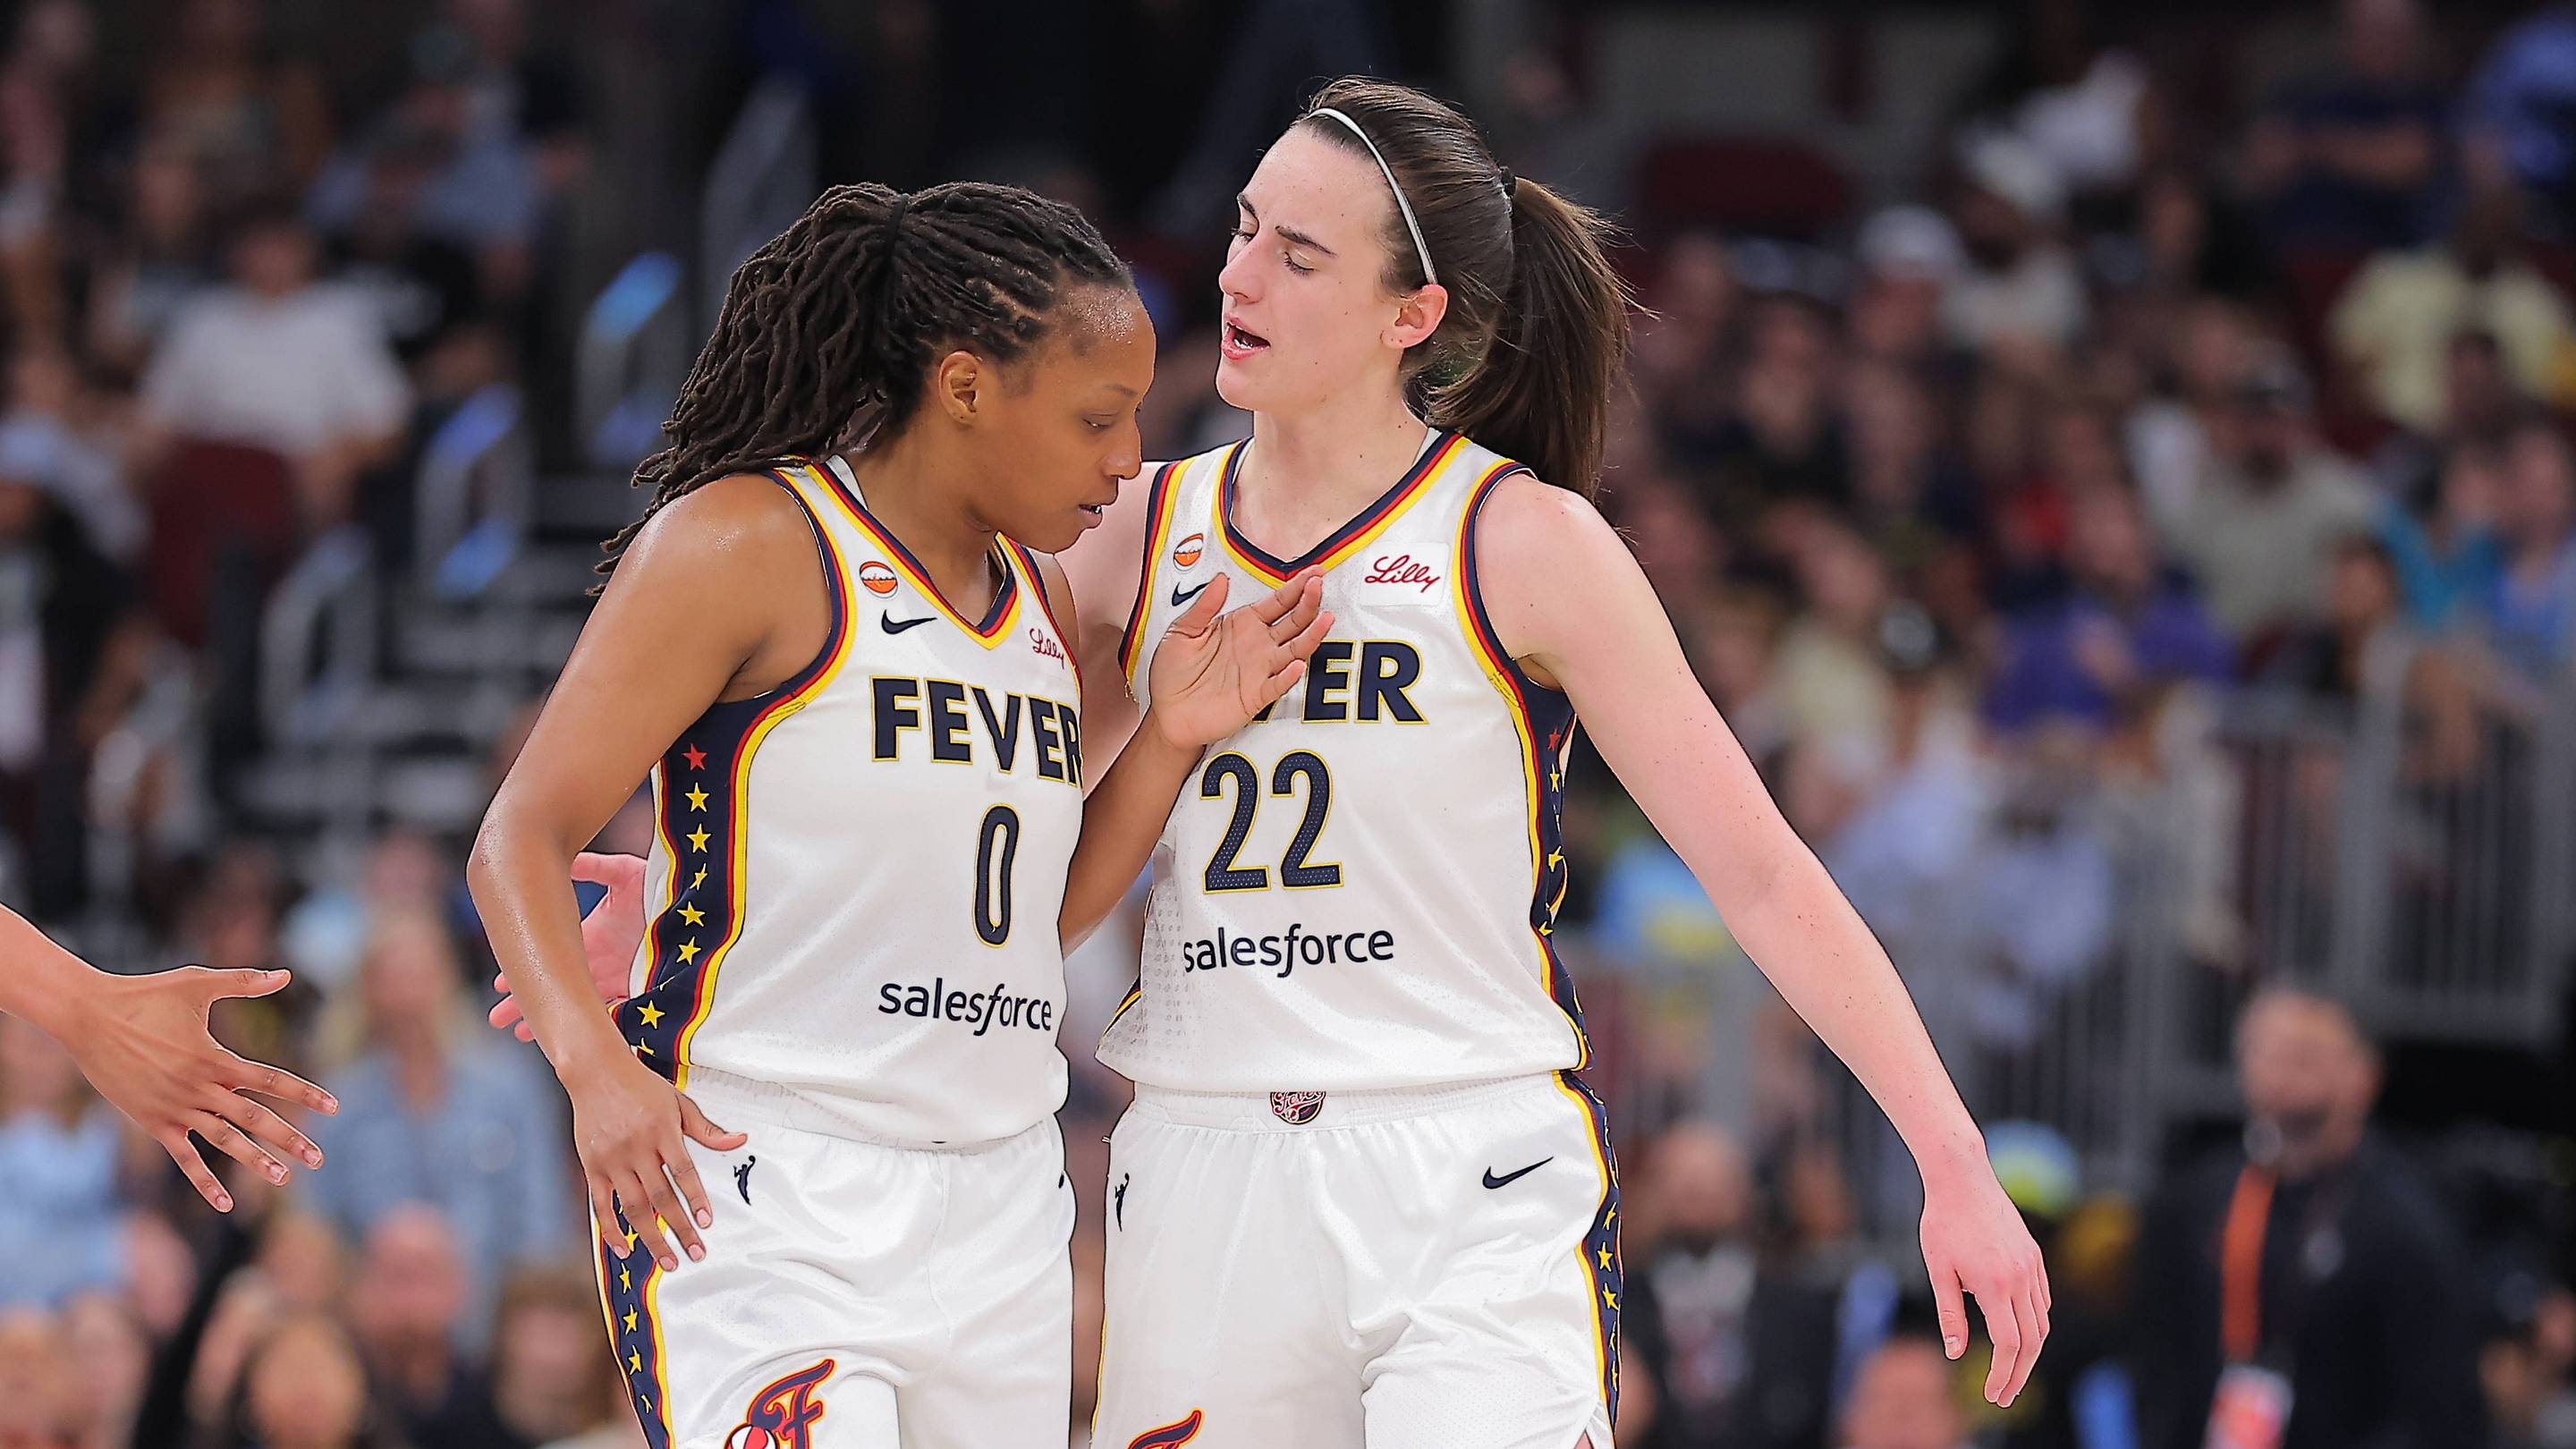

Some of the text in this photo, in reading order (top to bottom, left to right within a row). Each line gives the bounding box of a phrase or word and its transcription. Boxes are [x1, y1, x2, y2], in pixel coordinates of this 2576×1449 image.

[1364, 554, 1441, 594] Lilly
[1029, 628, 1065, 671] Lilly
[869, 674, 1084, 790] FEVER
[1199, 748, 1344, 895] 22
[972, 802, 1021, 949] 0
[1183, 923, 1394, 979] salesforce
[877, 977, 1053, 1038] salesforce
